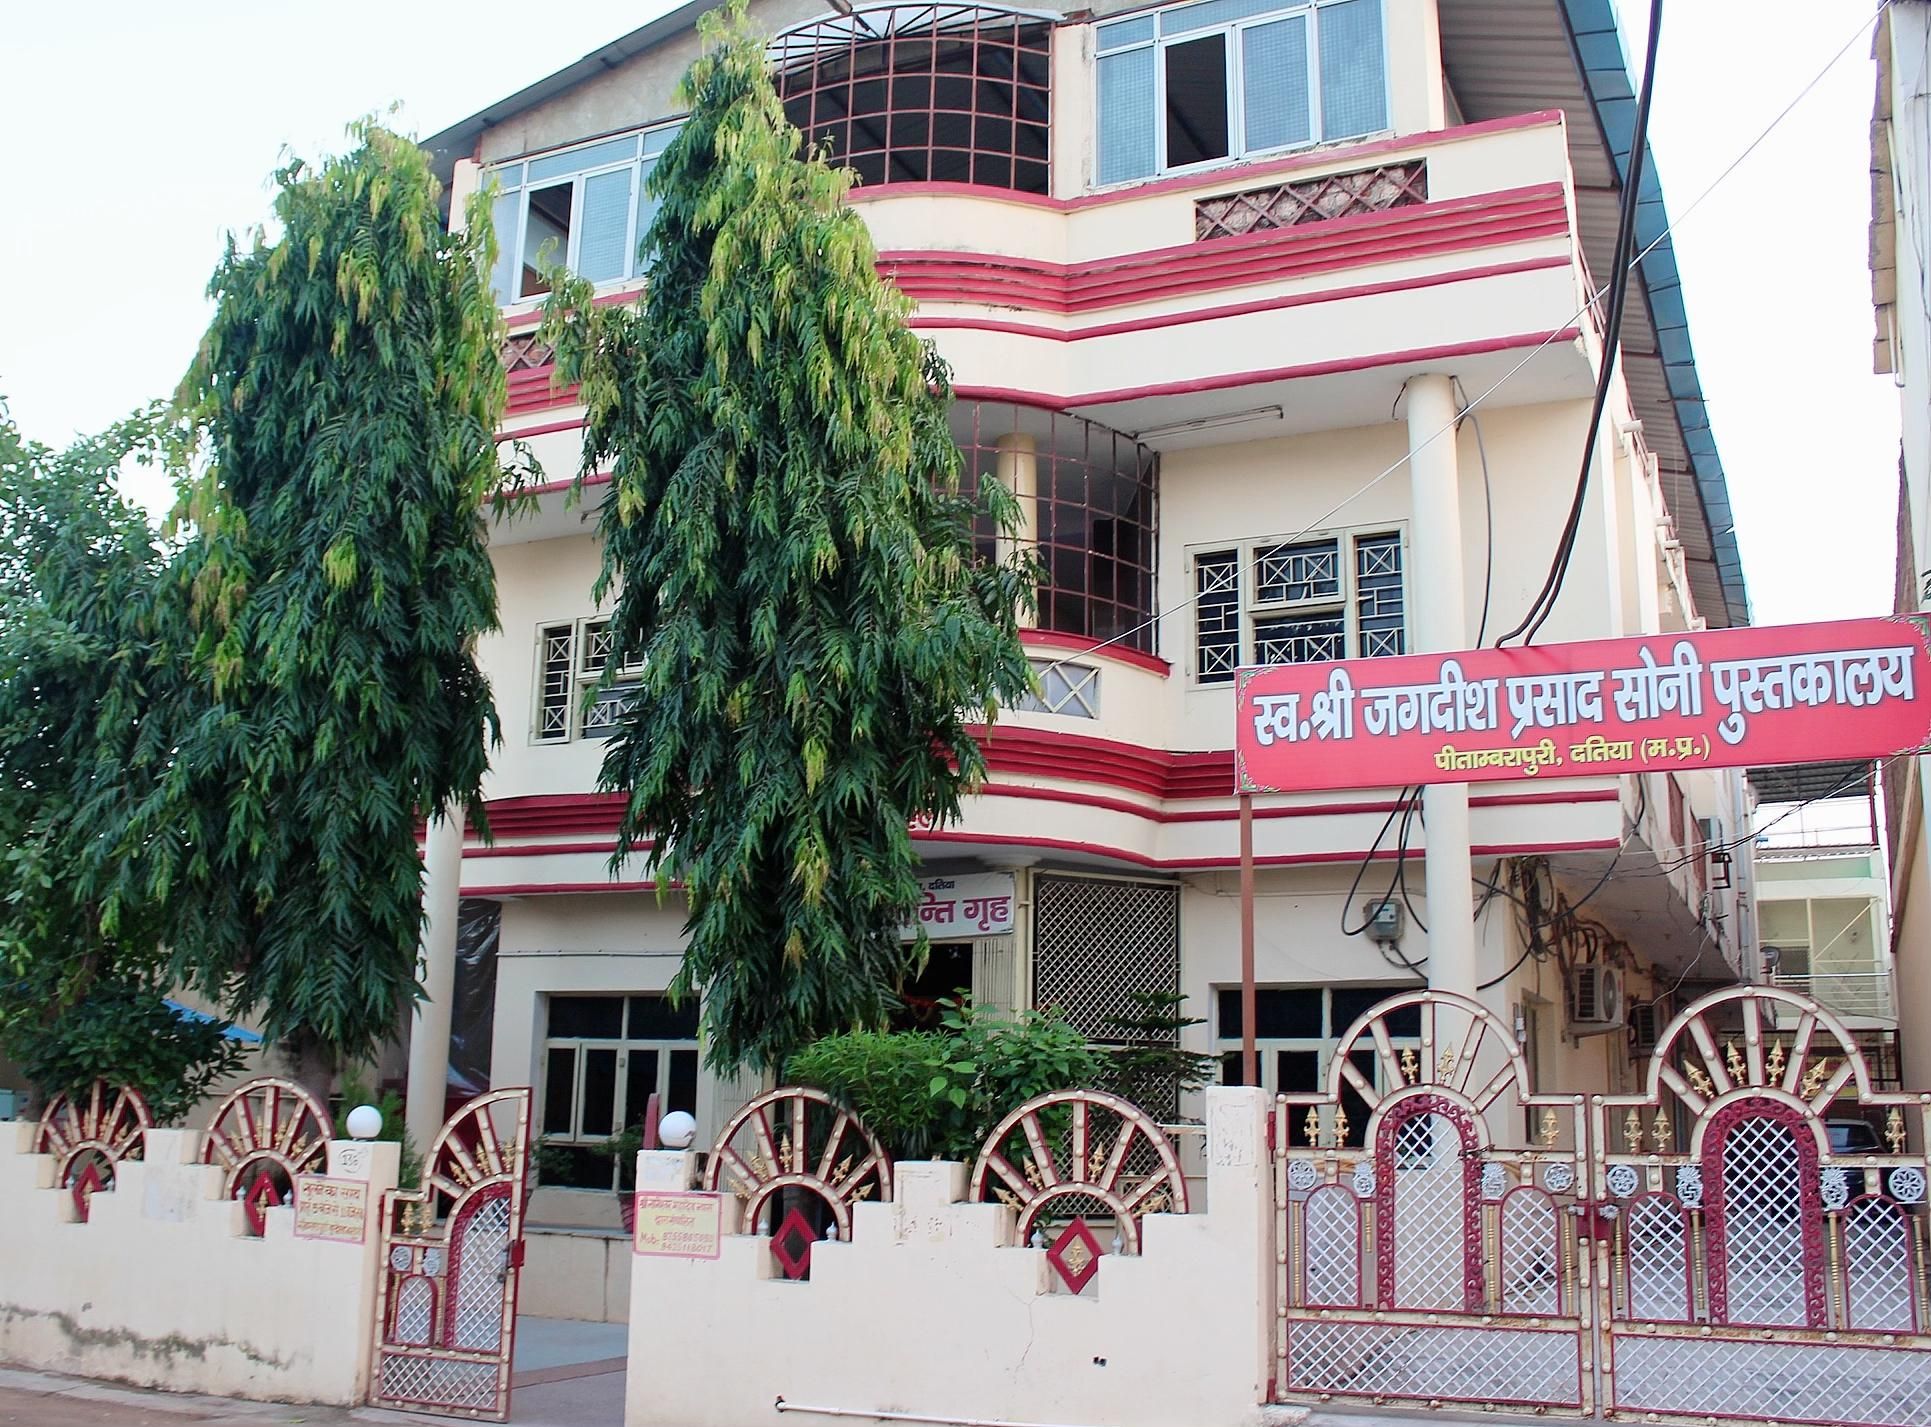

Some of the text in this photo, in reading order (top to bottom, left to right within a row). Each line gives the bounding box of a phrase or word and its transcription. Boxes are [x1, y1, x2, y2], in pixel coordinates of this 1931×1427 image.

[1360, 659, 1499, 736] जगदीश
[1505, 671, 1605, 740] प्रसाद
[1611, 641, 1703, 722] सोनी
[1710, 646, 1915, 745] पुस्तकालय
[1434, 738, 1563, 776] पीताम्बरापुरी,
[1569, 735, 1633, 763] दतिया
[963, 896, 1011, 931] गृह
